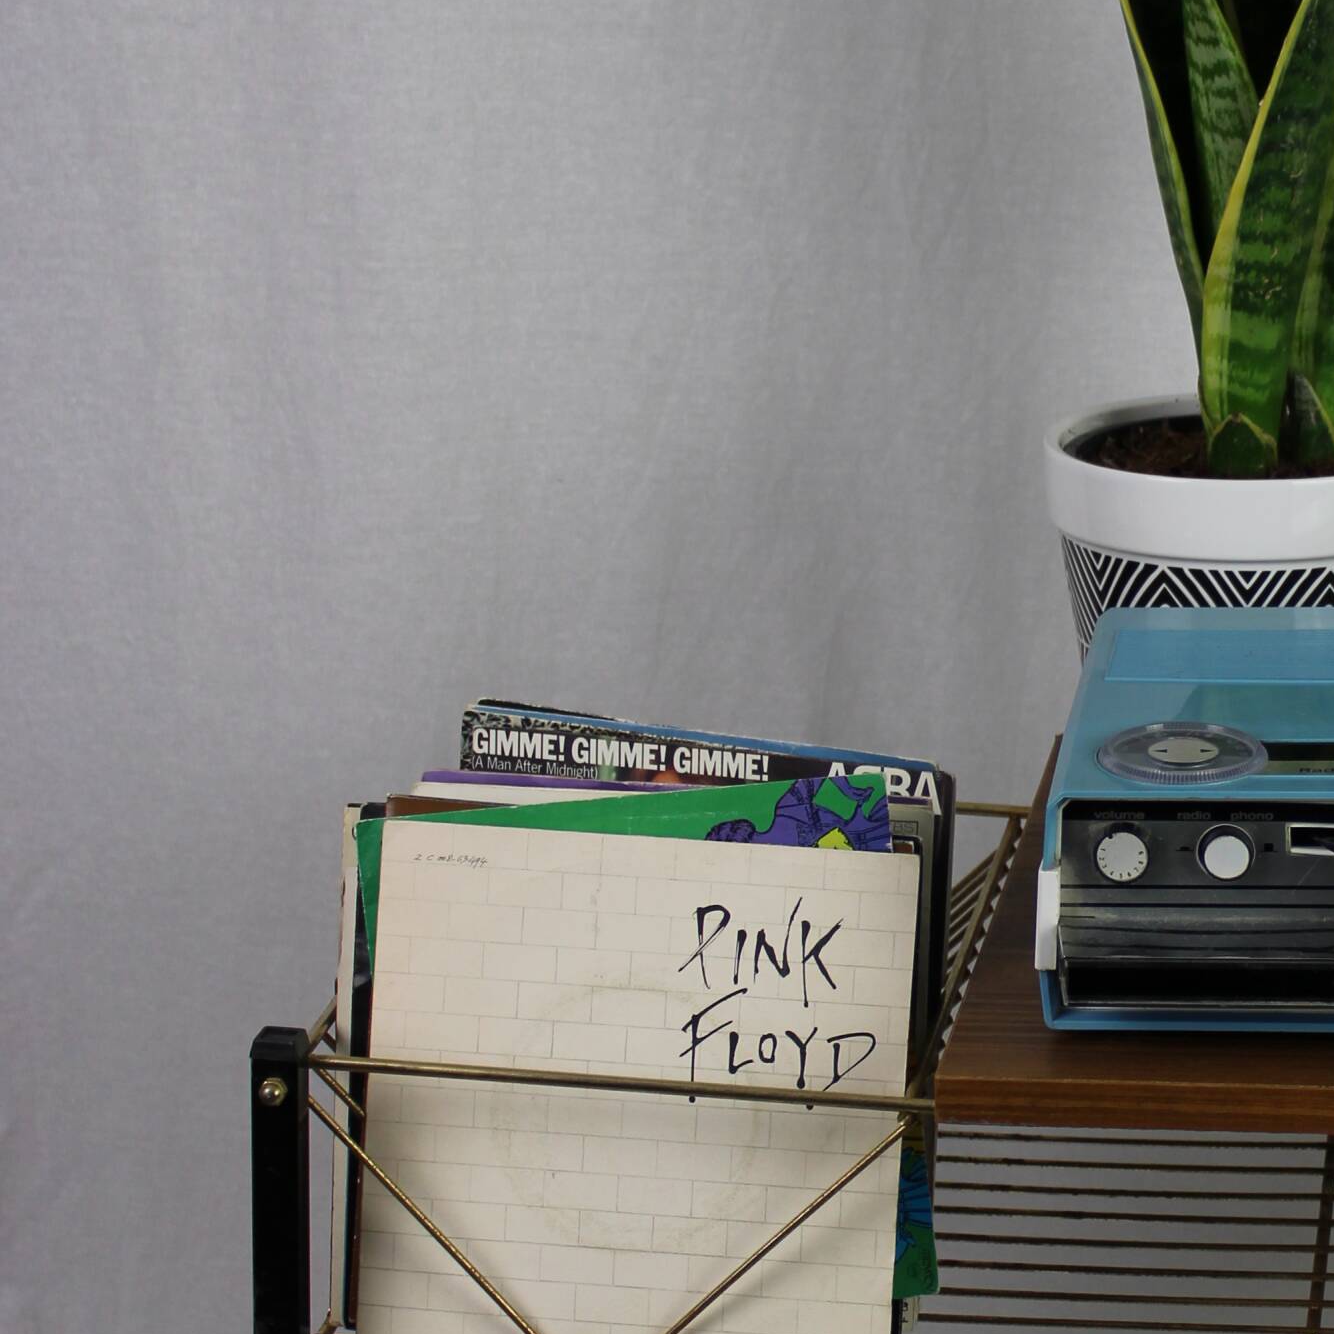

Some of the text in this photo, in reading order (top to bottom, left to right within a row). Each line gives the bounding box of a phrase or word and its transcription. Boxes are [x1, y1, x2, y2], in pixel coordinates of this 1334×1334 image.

[471, 757, 599, 780] (A Man After Midnight)
[472, 727, 770, 782] GIMME! GIMME! GIMME!
[1093, 810, 1146, 820] volume
[1176, 810, 1275, 822] radio phono
[679, 897, 844, 1007] PINK
[680, 987, 877, 1110] FLOYD
